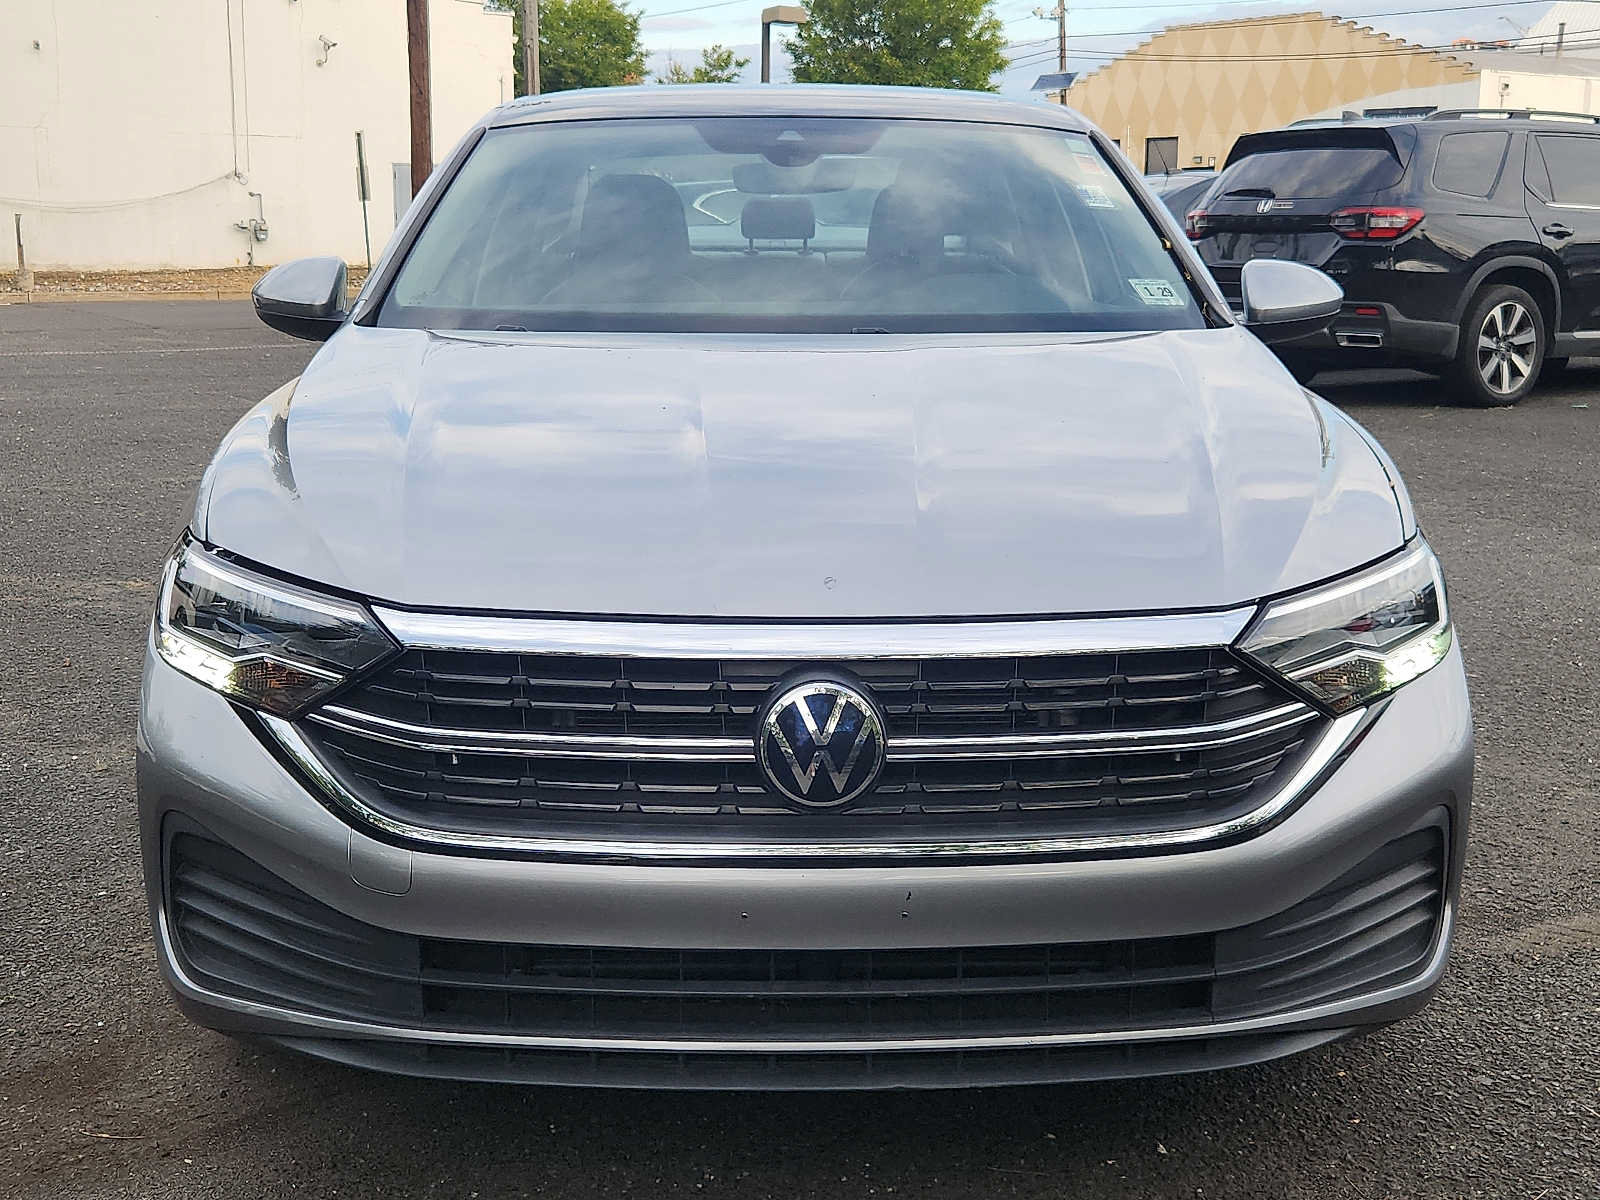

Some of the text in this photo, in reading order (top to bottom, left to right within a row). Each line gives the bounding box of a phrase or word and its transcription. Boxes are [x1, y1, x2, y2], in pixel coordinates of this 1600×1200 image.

[1143, 286, 1174, 297] 1 29
[764, 687, 877, 797] VW
